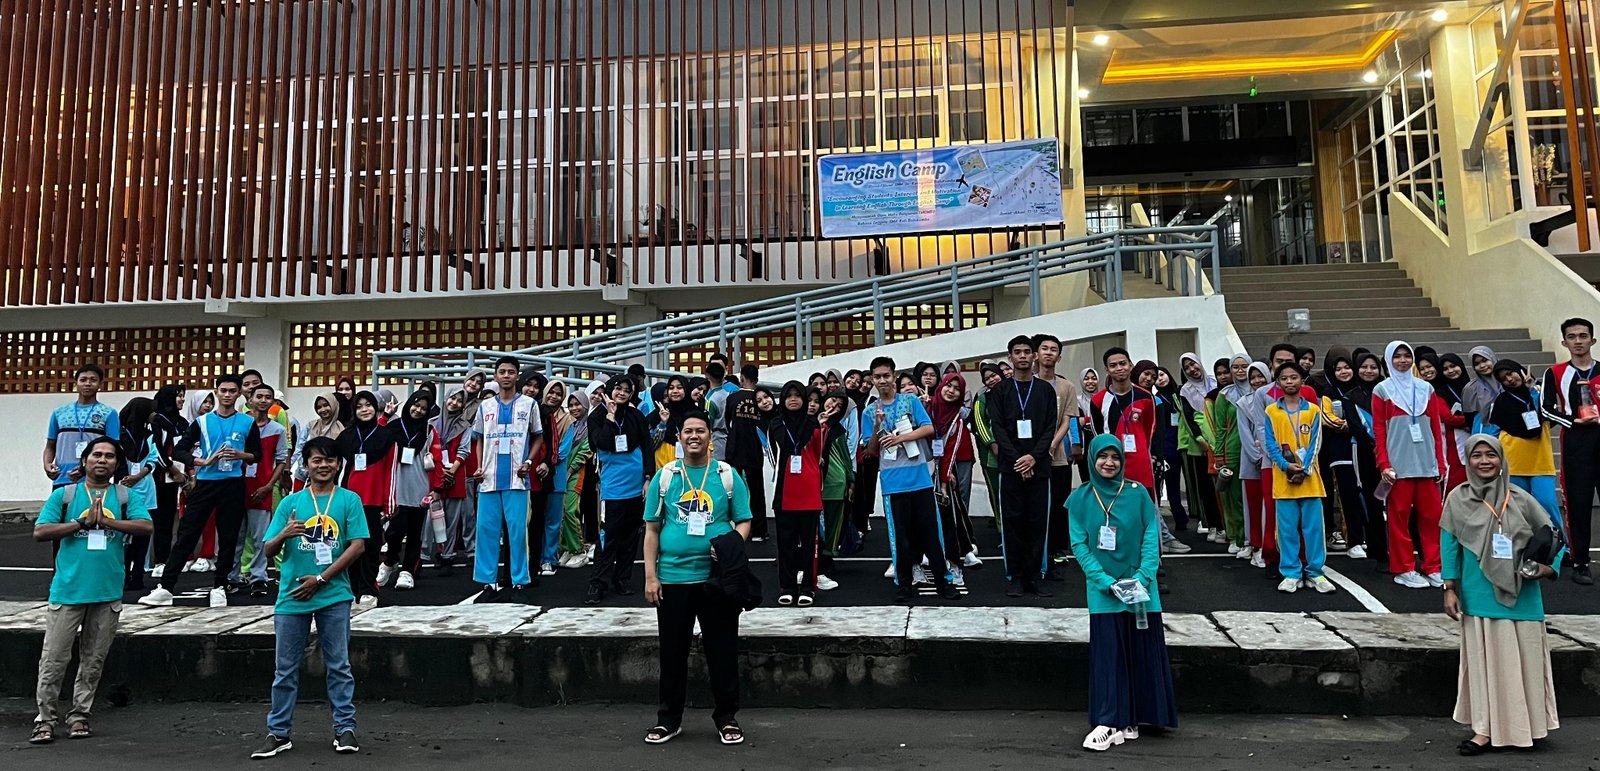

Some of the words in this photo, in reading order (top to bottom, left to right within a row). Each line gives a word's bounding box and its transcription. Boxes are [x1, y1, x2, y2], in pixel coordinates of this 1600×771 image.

[833, 164, 895, 186] English
[900, 162, 947, 180] Camp
[866, 201, 887, 209] English
[889, 200, 911, 208] Through
[743, 405, 755, 414] 14
[484, 413, 495, 422] 07
